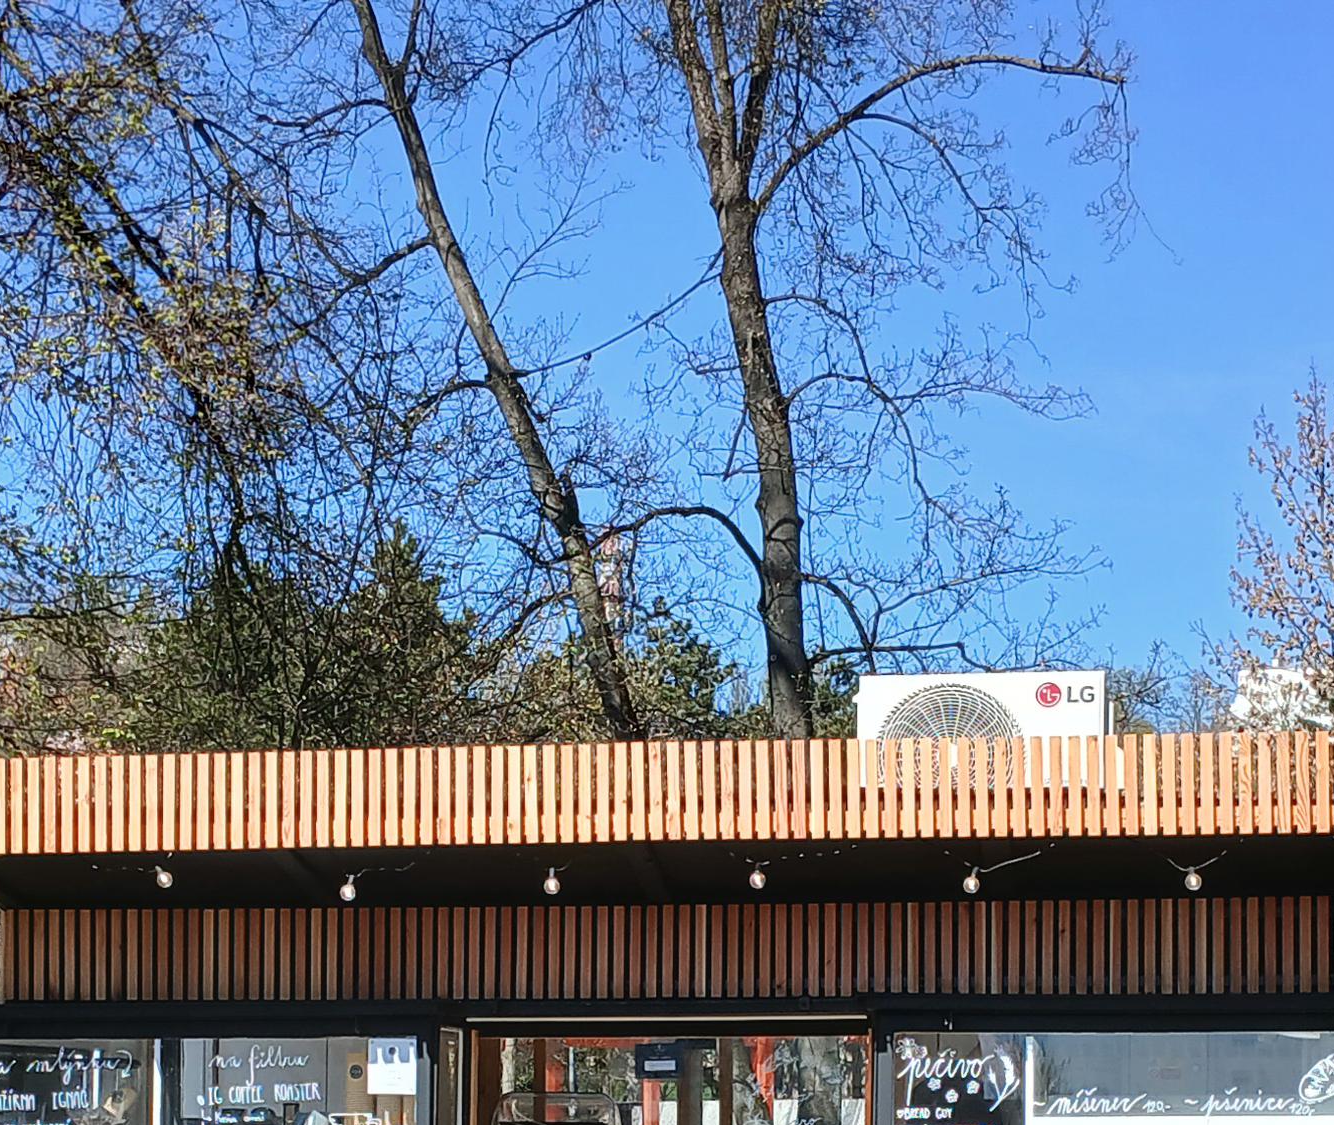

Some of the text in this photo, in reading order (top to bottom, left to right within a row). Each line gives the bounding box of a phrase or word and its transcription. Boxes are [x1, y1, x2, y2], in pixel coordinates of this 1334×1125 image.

[1067, 685, 1095, 703] LG
[207, 1044, 311, 1087] na filtru
[897, 1048, 995, 1107] pečivo
[51, 1085, 89, 1111] IGNÁC
[207, 1086, 223, 1106] IG
[274, 1083, 322, 1102] ROASTER
